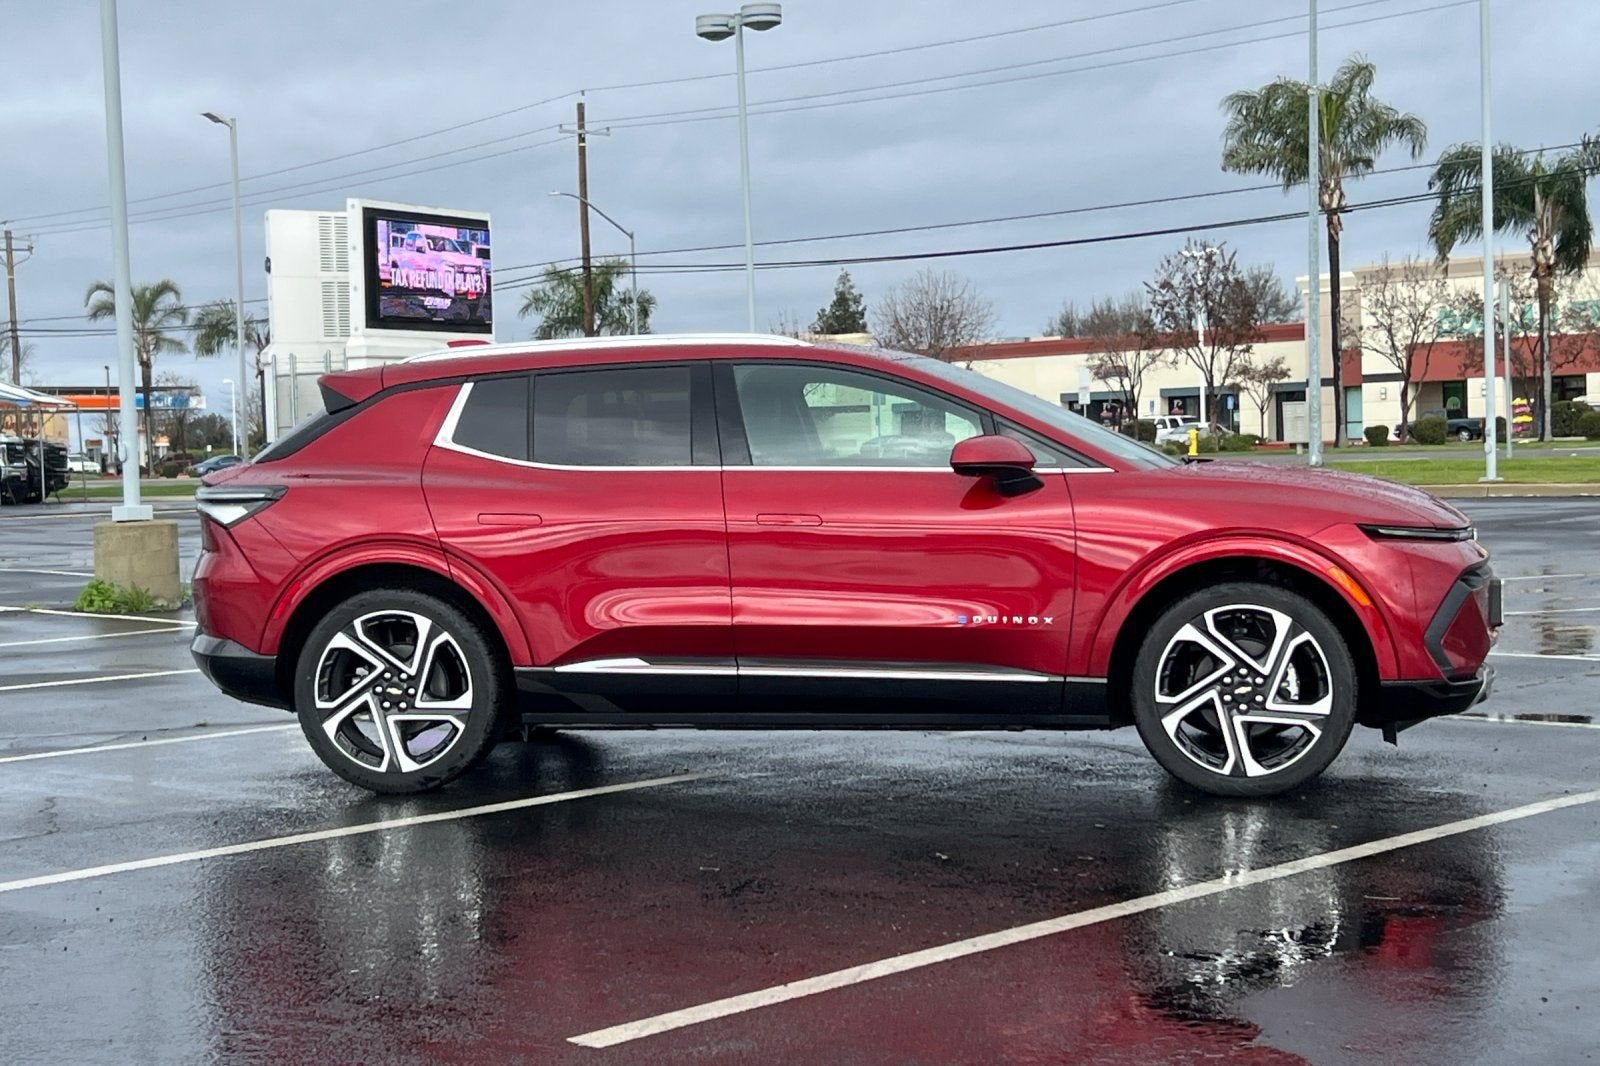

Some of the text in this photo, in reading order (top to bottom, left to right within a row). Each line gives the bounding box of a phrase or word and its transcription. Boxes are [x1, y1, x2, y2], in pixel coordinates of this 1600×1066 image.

[390, 268, 408, 287] TAX
[408, 269, 444, 290] REFUND
[957, 615, 1054, 625] EQUINOX
